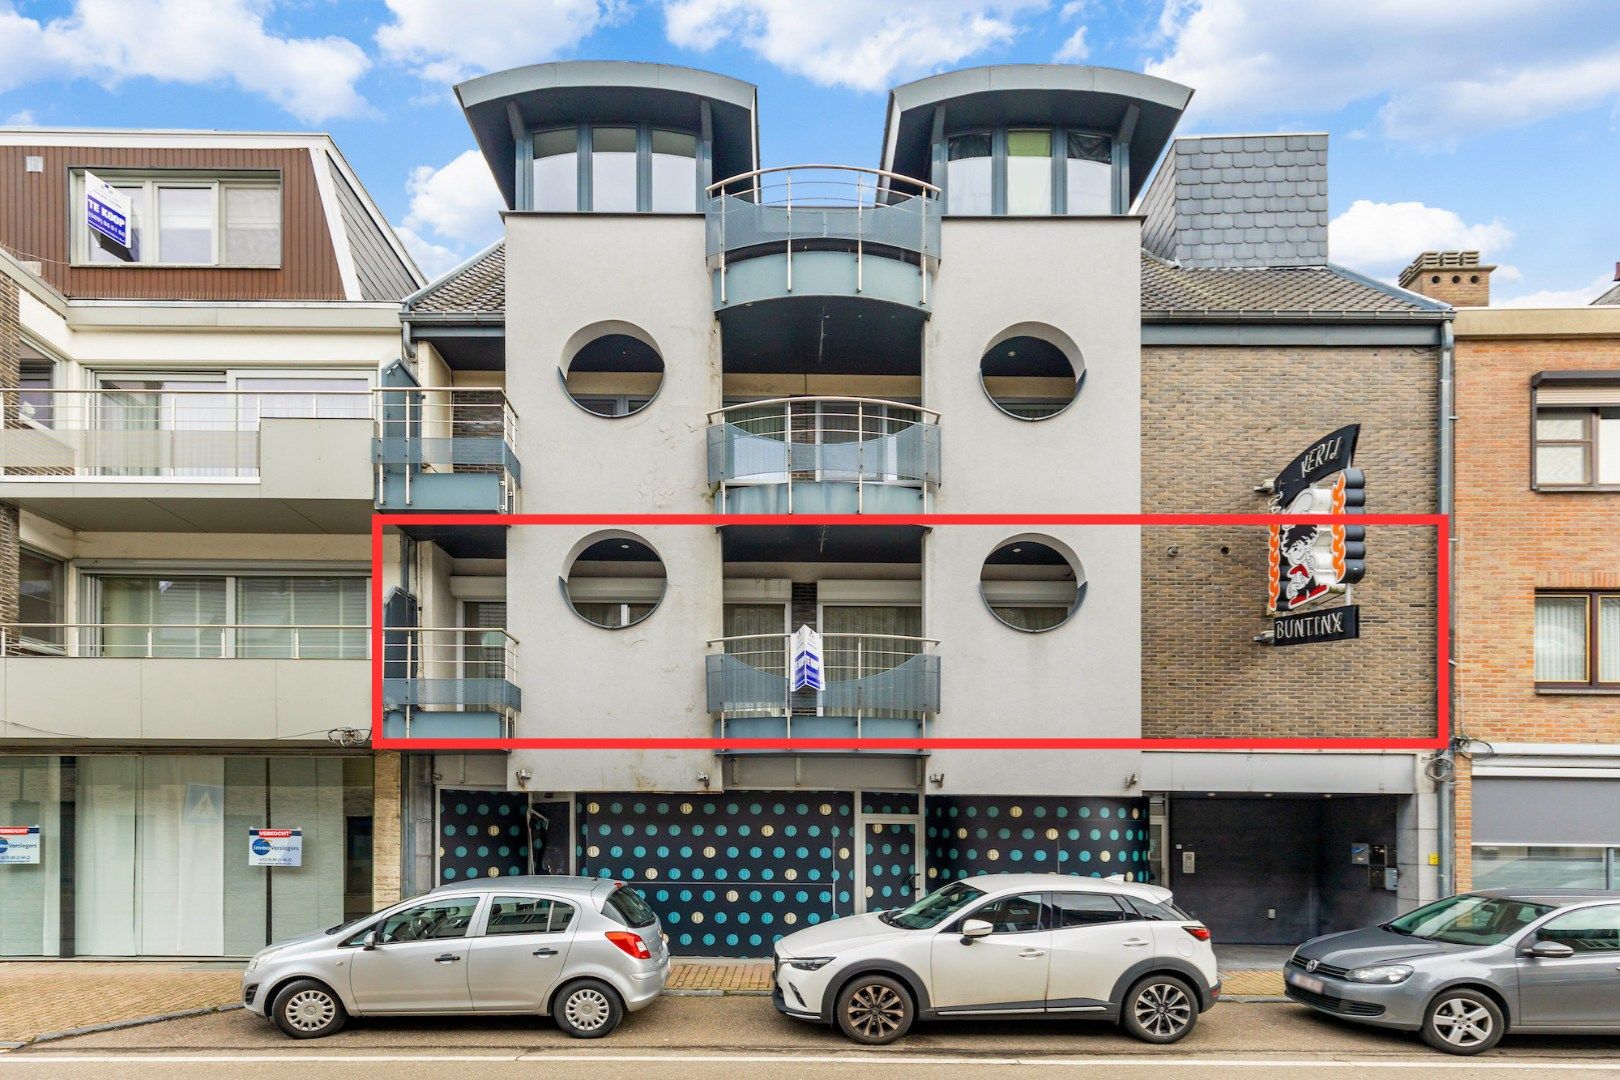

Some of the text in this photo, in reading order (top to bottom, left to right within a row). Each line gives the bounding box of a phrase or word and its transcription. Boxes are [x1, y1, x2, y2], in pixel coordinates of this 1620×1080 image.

[88, 199, 100, 213] TE
[101, 207, 125, 227] KOOP
[1275, 611, 1344, 639] BUNTINX
